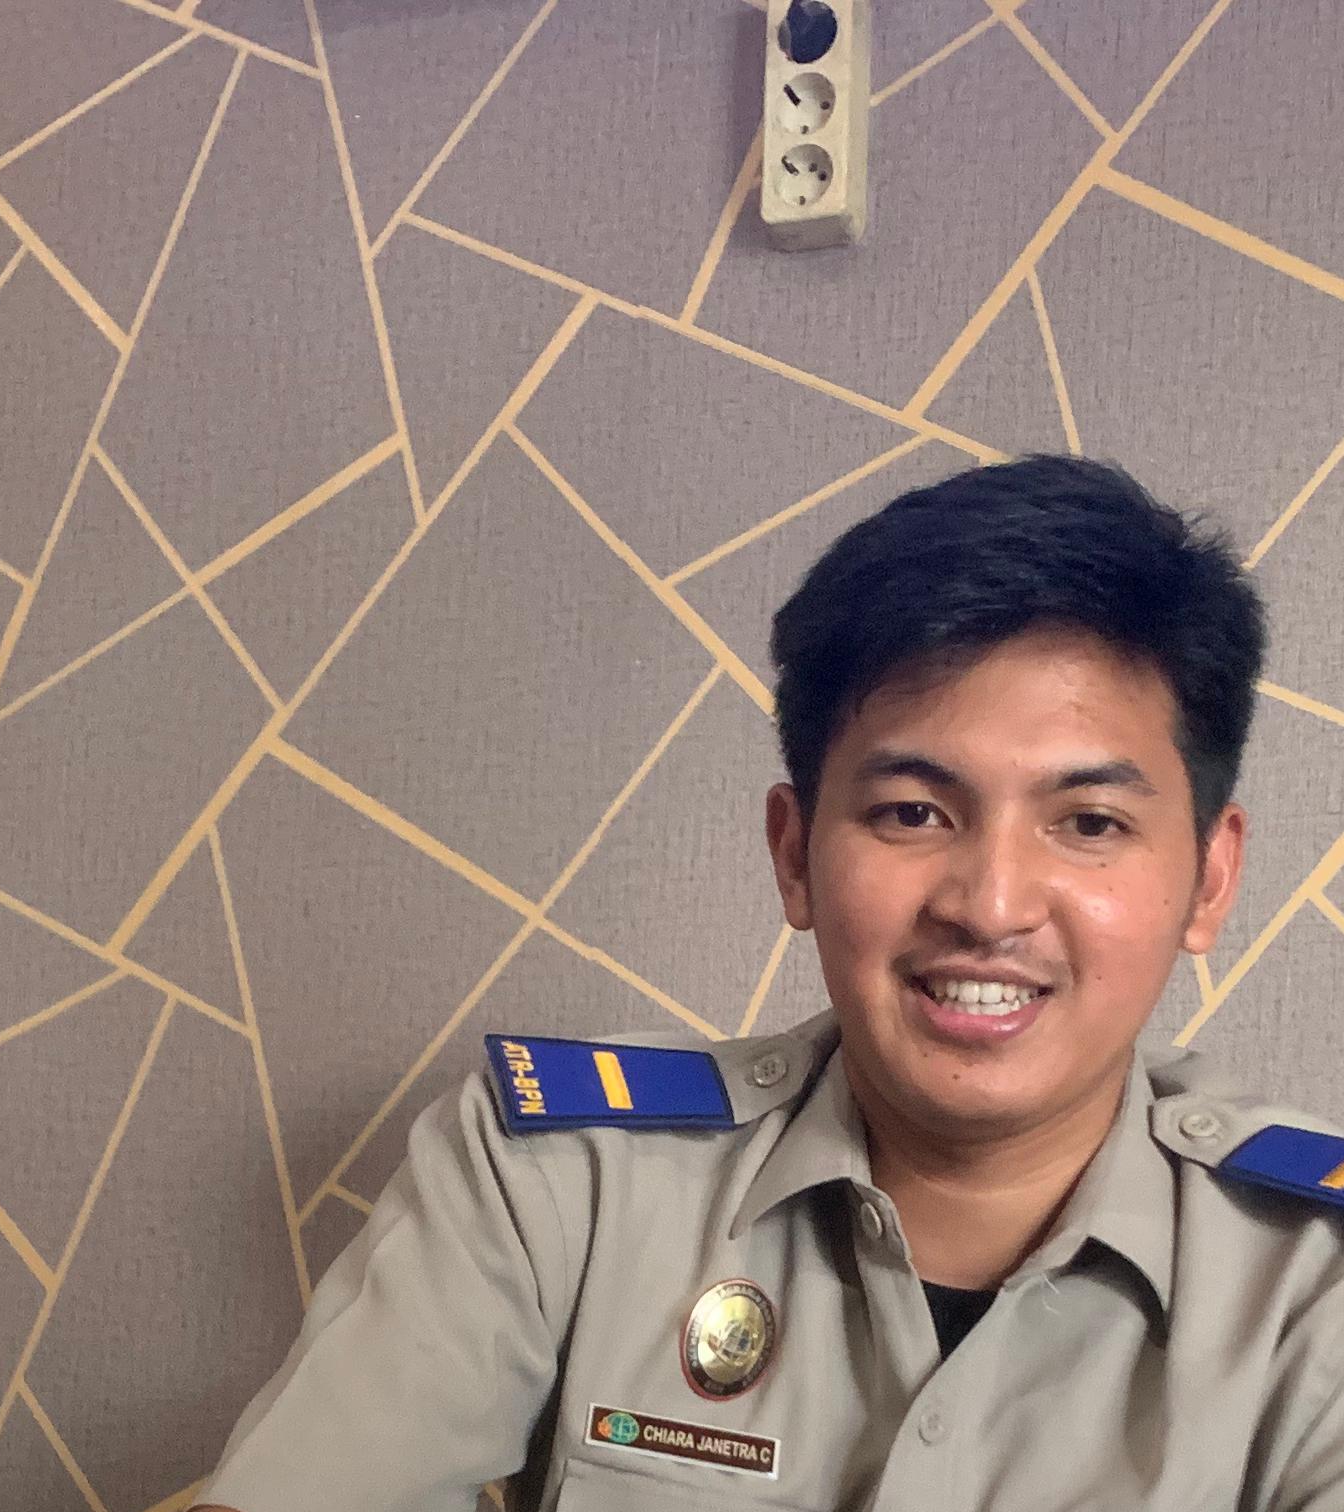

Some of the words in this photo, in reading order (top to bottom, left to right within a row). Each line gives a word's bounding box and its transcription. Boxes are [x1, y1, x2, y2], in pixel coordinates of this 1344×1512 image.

[501, 1040, 547, 1114] ATR-BPN
[643, 1425, 694, 1448] CHIARA
[696, 1436, 757, 1460] JANETRA
[759, 1447, 771, 1464] C
